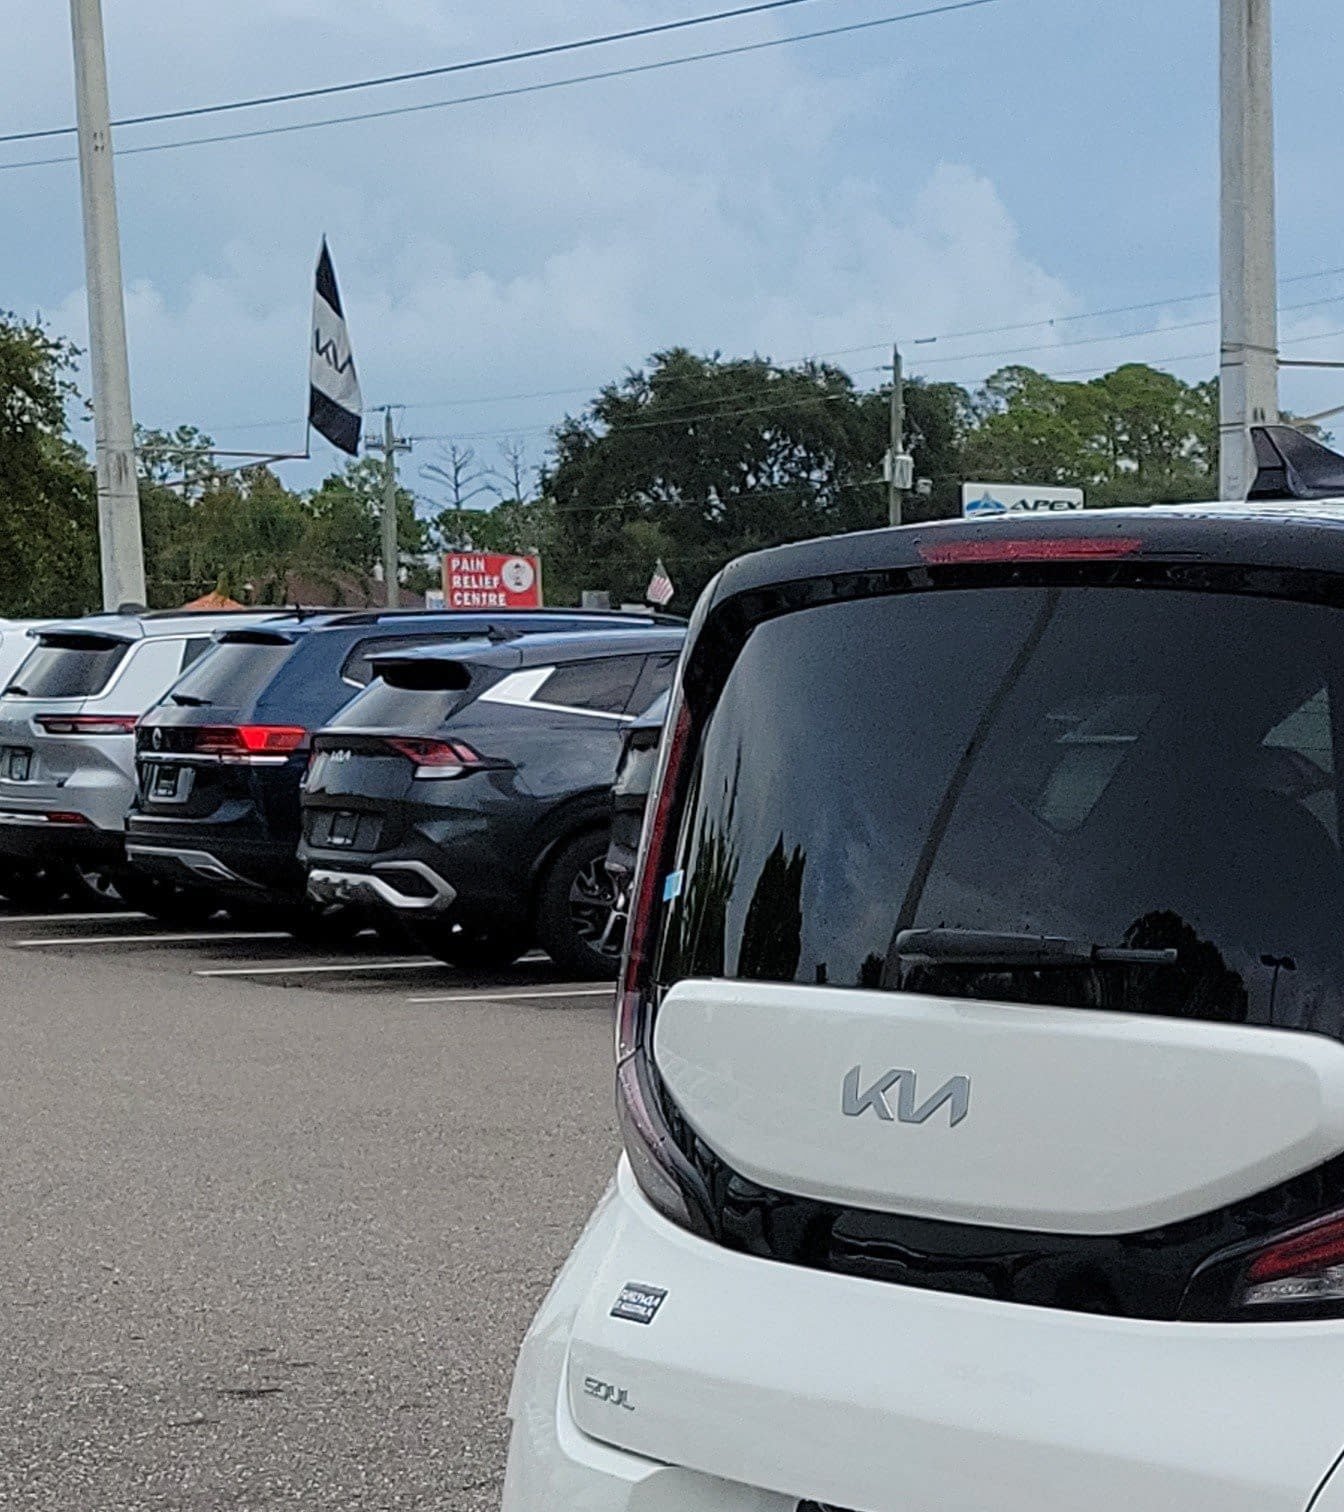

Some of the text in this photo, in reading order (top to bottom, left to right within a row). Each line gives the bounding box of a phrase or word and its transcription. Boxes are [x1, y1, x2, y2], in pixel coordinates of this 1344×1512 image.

[1010, 498, 1081, 512] APEX
[451, 557, 485, 572] PAIN
[452, 575, 500, 589] RELIEF
[453, 591, 507, 607] CENTRE
[842, 1064, 971, 1128] KIA
[584, 1376, 636, 1411] SOUL
